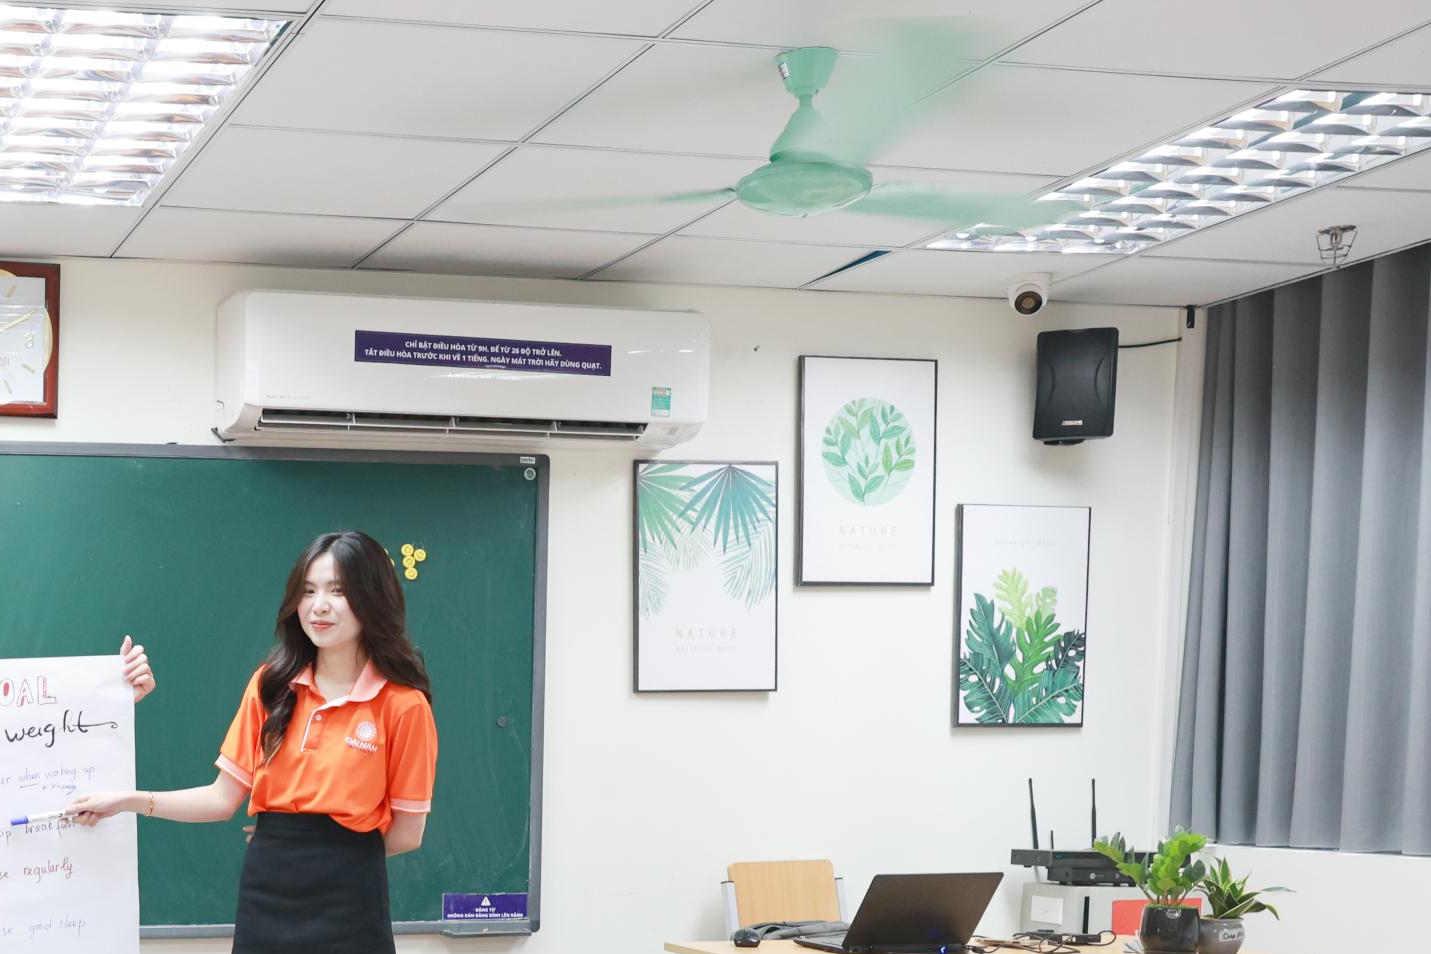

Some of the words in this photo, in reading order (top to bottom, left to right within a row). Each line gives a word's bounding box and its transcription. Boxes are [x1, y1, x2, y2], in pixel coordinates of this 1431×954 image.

[839, 525, 898, 537] NATURE
[675, 627, 738, 639] NATURE
[4, 709, 119, 748] weight
[19, 768, 40, 783] when
[83, 766, 96, 781] up
